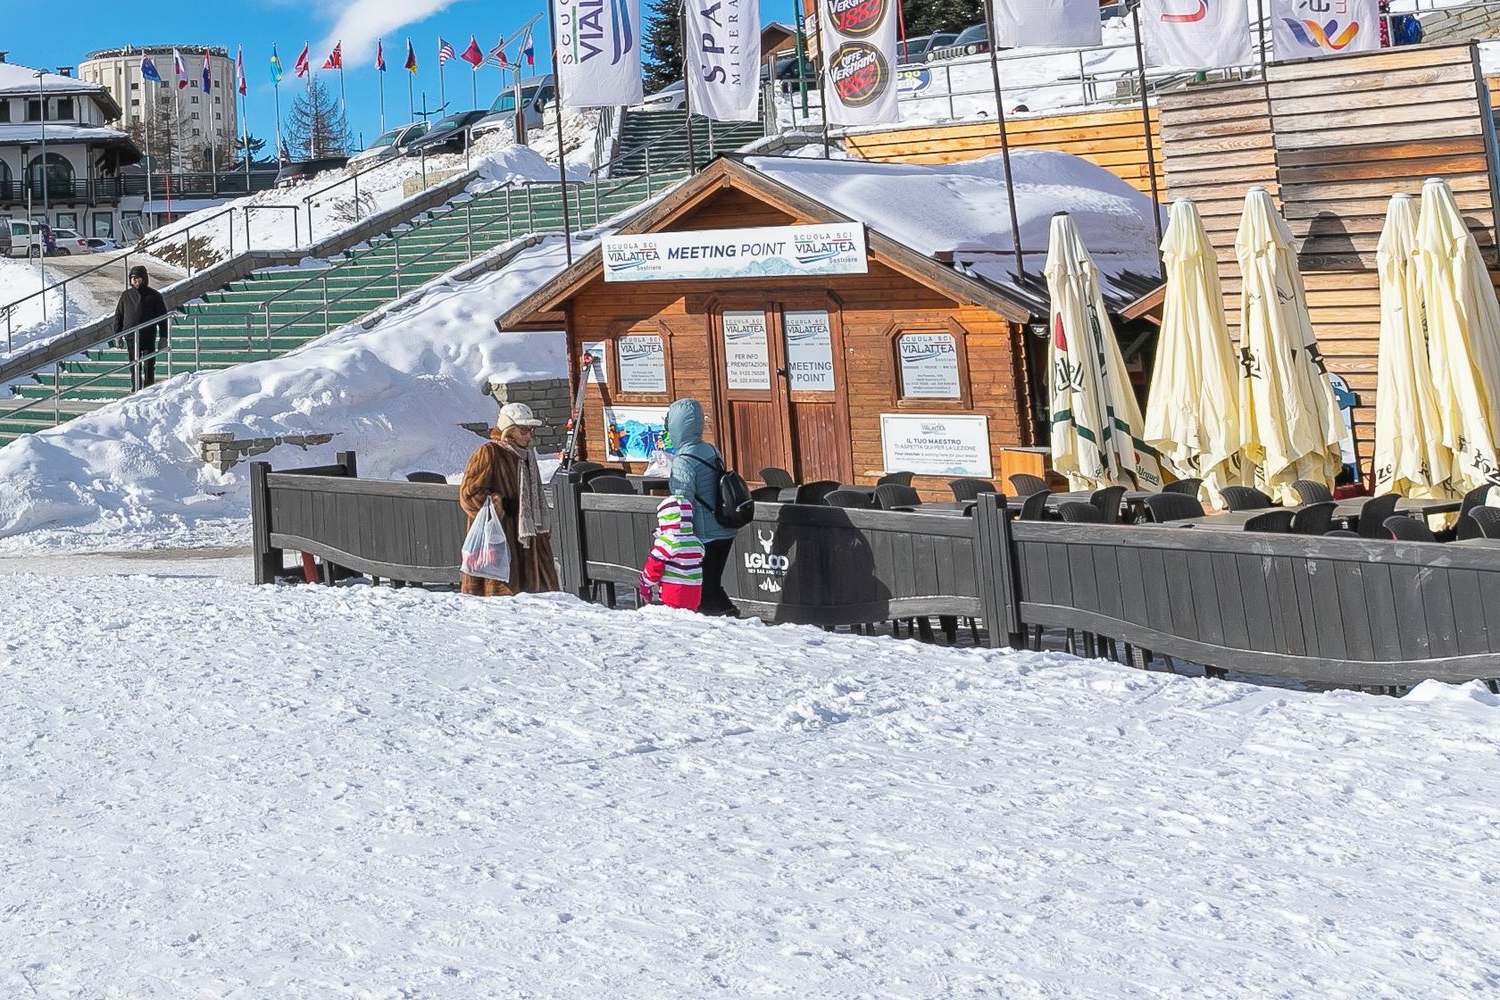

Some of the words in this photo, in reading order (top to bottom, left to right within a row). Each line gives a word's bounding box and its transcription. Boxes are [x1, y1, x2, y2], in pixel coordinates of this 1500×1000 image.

[667, 245, 736, 260] MEETING
[740, 242, 786, 257] POINT
[795, 241, 856, 253] VIALATTEA
[608, 251, 661, 262] VIALATTEA
[726, 325, 765, 333] VIALATTEA
[788, 325, 829, 333] VIALATTEA
[621, 344, 663, 353] VIALATTEA
[902, 344, 955, 353] VIALATTEA
[789, 361, 831, 371] MEETING
[796, 373, 825, 382] POINT
